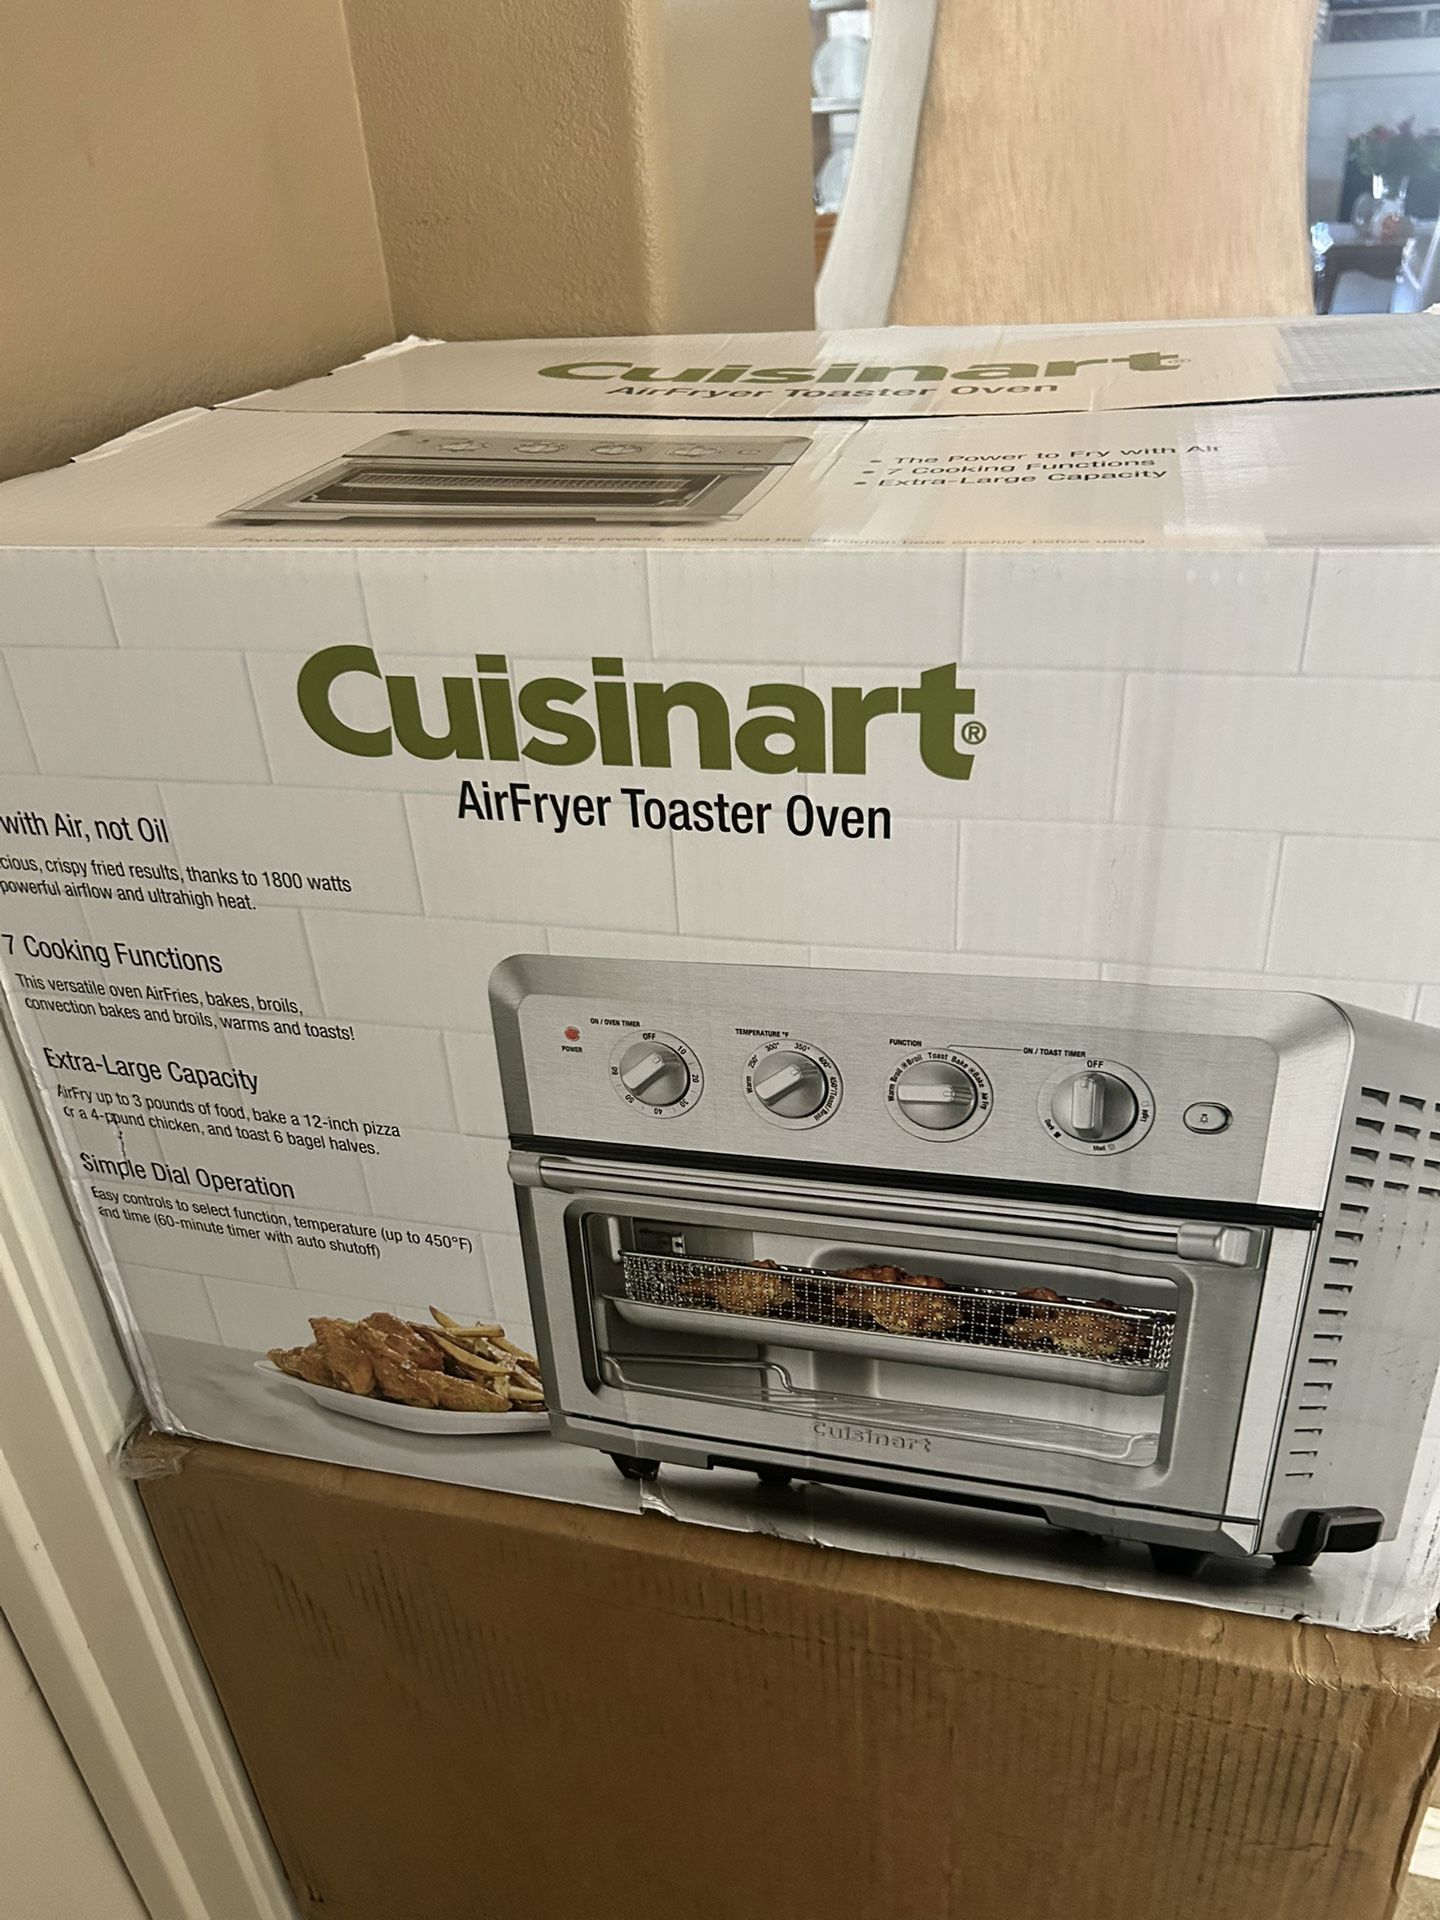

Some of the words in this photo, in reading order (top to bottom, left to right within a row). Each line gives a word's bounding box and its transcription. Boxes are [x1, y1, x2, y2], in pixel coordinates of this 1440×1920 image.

[605, 386, 772, 399] AirFryer
[785, 386, 937, 399] Toaster
[951, 383, 1058, 396] Oven
[894, 457, 939, 465] The
[947, 454, 1028, 463] Power
[1036, 452, 1060, 460] to
[1070, 450, 1110, 459] Fry
[1120, 446, 1177, 455] with
[1186, 445, 1222, 454] Air
[911, 465, 1015, 475] Cooking
[1026, 459, 1155, 471] Functions
[878, 475, 1037, 487] Extra-Large
[1047, 470, 1167, 482] Capacity
[458, 779, 611, 833] AirFryer
[621, 787, 772, 835] Toaster
[786, 794, 892, 840] Oven
[0, 811, 49, 836] with
[55, 812, 91, 843] Air,
[94, 817, 134, 842] not
[137, 817, 169, 843] Oil
[45, 857, 87, 878] crispy
[91, 859, 125, 877] fried
[129, 864, 185, 884] results,
[186, 866, 239, 885] thanks
[241, 870, 258, 886] to
[261, 871, 303, 889] 1800
[306, 876, 352, 893] watts
[0, 879, 61, 896] powerful
[64, 882, 113, 900] airflow
[117, 886, 144, 902] and
[148, 889, 214, 910] ultrahigh
[217, 892, 257, 911] heat.
[1, 933, 14, 955] 7
[23, 935, 111, 968] Cooking
[114, 942, 223, 974] Functions
[15, 973, 46, 990] This
[50, 979, 106, 996] versatile
[109, 984, 143, 999] oven
[146, 985, 204, 1007] AirFries,
[205, 991, 255, 1012] bakes,
[256, 996, 304, 1017] broils,
[25, 997, 96, 1016] convection
[99, 1002, 141, 1020] bakes
[144, 1009, 170, 1023] and
[174, 1008, 218, 1030] broils,
[219, 1017, 270, 1033] warms
[274, 1021, 301, 1036] and
[304, 1022, 355, 1041] toasts!
[590, 1017, 600, 1025] ON
[604, 1018, 621, 1026] OVEN
[621, 1019, 641, 1028] TIMER
[642, 1032, 657, 1041] OFF
[735, 1028, 781, 1038] TEMPERATURE
[561, 1045, 583, 1053] POWER
[677, 1045, 687, 1056] 10
[889, 1038, 922, 1047] FUNCTION
[905, 1054, 923, 1066] Broil
[927, 1051, 949, 1061] Toast
[1023, 1047, 1034, 1055] ON
[1040, 1047, 1062, 1057] TOAST
[1064, 1049, 1087, 1058] TIMER
[951, 1055, 969, 1069] Bake
[1086, 1060, 1104, 1069] OFF
[43, 1047, 162, 1083] Extra-Large
[167, 1061, 258, 1095] Capacity
[610, 1066, 619, 1076] 60
[692, 1073, 700, 1084] 20
[890, 1067, 904, 1083] Broil
[972, 1071, 986, 1089] Bake
[625, 1093, 635, 1104] 50
[887, 1083, 896, 1102] Warm
[57, 1084, 92, 1104] AirFry
[96, 1092, 113, 1106] up
[115, 1092, 130, 1106] to
[132, 1093, 142, 1107] 3
[145, 1097, 195, 1114] pounds
[198, 1102, 212, 1116] of
[214, 1103, 251, 1122] food,
[252, 1108, 287, 1125] bake
[290, 1114, 300, 1126] a
[303, 1114, 359, 1133] 12-inch
[363, 1120, 401, 1137] pizza
[653, 1106, 663, 1115] 40
[679, 1098, 689, 1108] 30
[79, 1108, 89, 1120] a
[149, 1115, 205, 1136] chicken,
[207, 1121, 233, 1138] and
[235, 1125, 271, 1143] toast
[273, 1130, 284, 1144] 6
[286, 1131, 326, 1151] bagel
[329, 1136, 381, 1156] halves.
[80, 1152, 147, 1180] Simple
[151, 1162, 191, 1186] Dial
[196, 1168, 296, 1200] Operation
[91, 1185, 119, 1204] Easy
[123, 1193, 174, 1210] controls
[175, 1199, 189, 1213] to
[192, 1202, 232, 1218] select
[233, 1206, 292, 1228] function,
[293, 1214, 377, 1239] temperature
[381, 1227, 403, 1244] (up
[406, 1230, 421, 1245] to
[425, 1233, 474, 1254] 450°F)
[98, 1206, 121, 1220] and
[122, 1208, 151, 1224] time
[154, 1211, 225, 1235] (60-minute
[226, 1223, 262, 1241] timer
[264, 1229, 294, 1245] with
[296, 1234, 327, 1250] auto
[329, 1239, 381, 1260] shutoff)
[813, 1421, 932, 1453] Cuisinart
